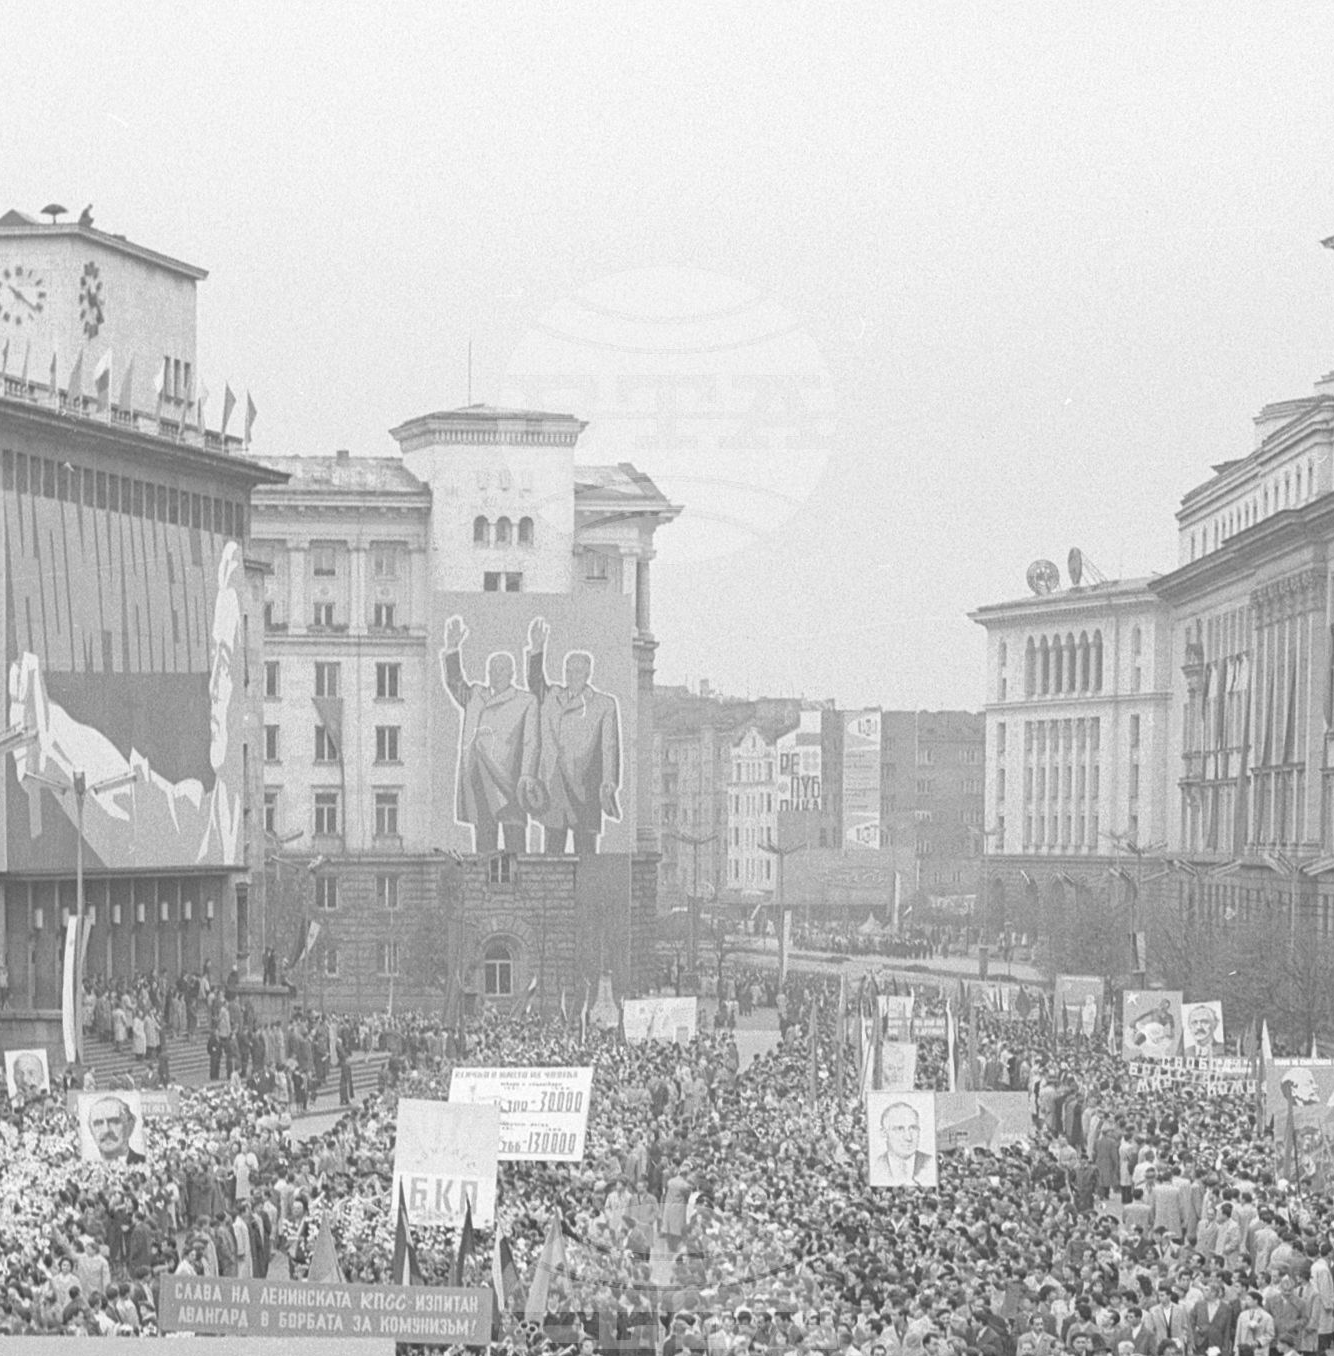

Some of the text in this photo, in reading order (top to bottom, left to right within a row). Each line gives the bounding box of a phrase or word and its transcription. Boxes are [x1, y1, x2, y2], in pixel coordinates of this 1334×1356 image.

[779, 753, 800, 775] РЕ
[790, 775, 822, 798] ПУБ
[410, 1177, 478, 1215] БКП
[175, 1282, 222, 1302] СЛАВА
[231, 1285, 250, 1304] НА
[260, 1287, 352, 1308] ЛЕНИНСКАТА
[178, 1306, 477, 1337] АВАНГАРД В БОРБАТА ЗА КОМУНИЗЪМ!
